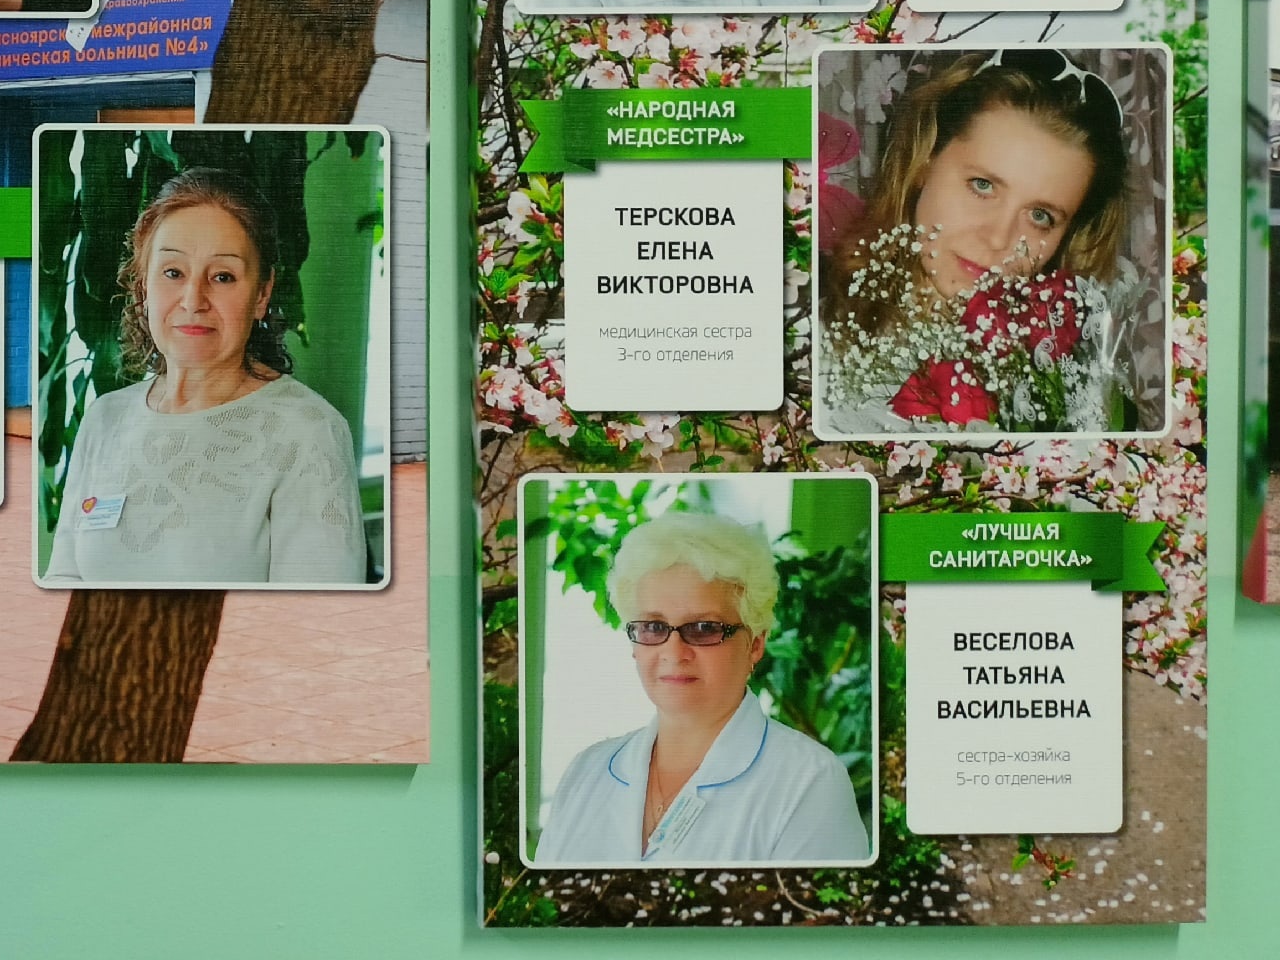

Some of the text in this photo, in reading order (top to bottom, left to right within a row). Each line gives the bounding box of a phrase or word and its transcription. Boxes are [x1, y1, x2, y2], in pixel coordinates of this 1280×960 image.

[91, 16, 212, 39] межрайонная
[166, 36, 208, 56] №4»
[607, 100, 735, 120] «НАРОДНАЯ
[607, 128, 745, 147] МЕДСЕСТРА»
[615, 207, 736, 226] ТЕРСКОВА
[637, 241, 714, 260] ЕЛЕНА
[597, 275, 754, 294] ВИКТОРОВНА
[599, 325, 752, 340] медицинская сестра
[618, 348, 734, 362] 3-го отделения
[962, 523, 1059, 541] «ЛУЧШАЯ
[929, 549, 1092, 568] САНИТАРОЧКА»
[954, 632, 1075, 651] ВЕСЕЛОВА
[963, 665, 1065, 685] ТАТЬЯНА
[937, 699, 1091, 719] ВАСИЛЬЕВНА
[957, 747, 1071, 764] сестра-хозяйка
[956, 772, 1072, 786] 5-го отделения
